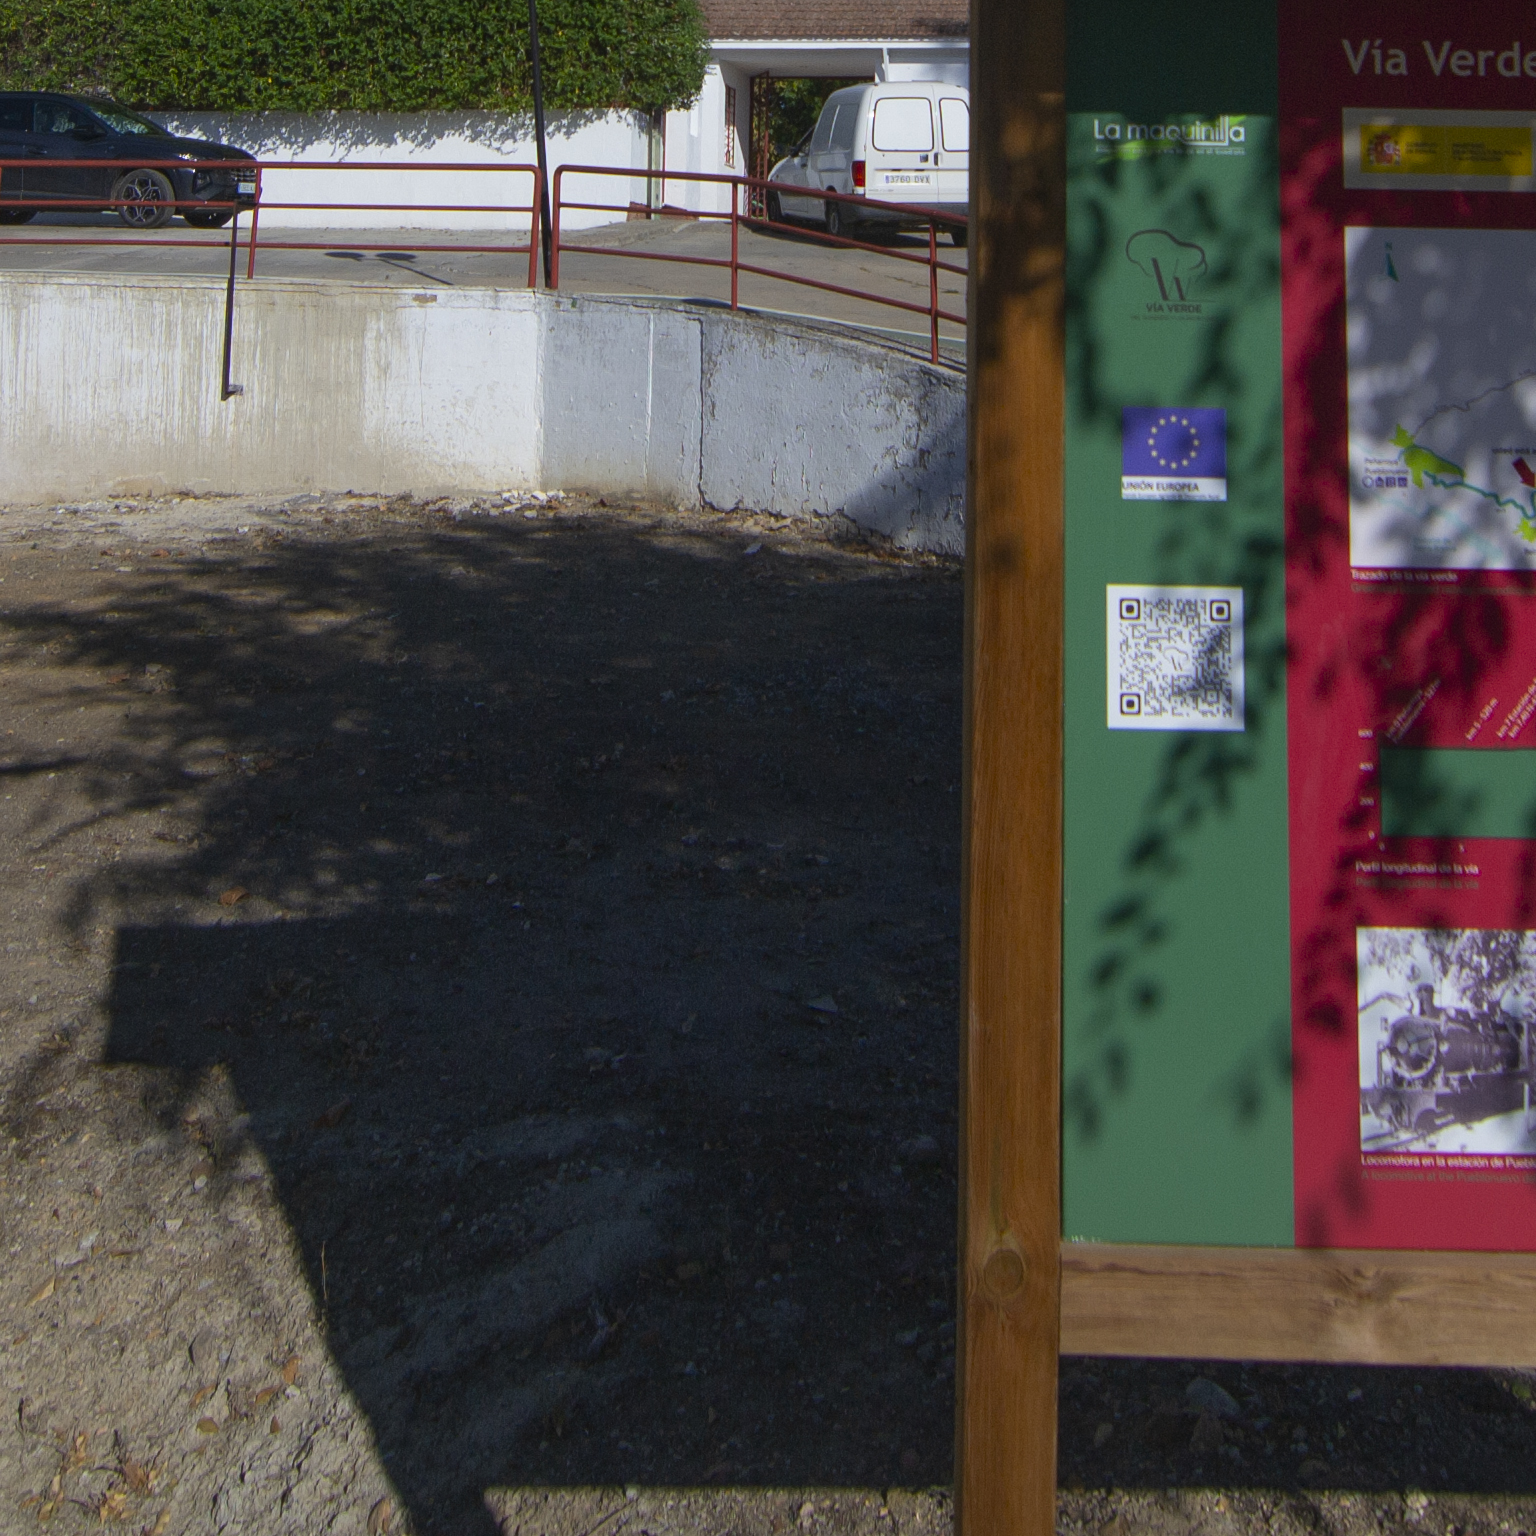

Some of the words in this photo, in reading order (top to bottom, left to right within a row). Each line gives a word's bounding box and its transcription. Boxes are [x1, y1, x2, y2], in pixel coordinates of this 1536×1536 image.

[1342, 39, 1408, 77] Vía
[1094, 119, 1121, 141] La
[1146, 300, 1164, 314] VÍA
[1166, 303, 1202, 314] VERDE
[1123, 480, 1154, 492] UNIÓN
[1156, 482, 1200, 493] EUROPEA
[1356, 860, 1380, 873] Perfil
[1382, 861, 1438, 876] longitudinal
[1439, 863, 1452, 874] de
[1453, 863, 1462, 875] la
[1361, 1154, 1420, 1168] Locomotora
